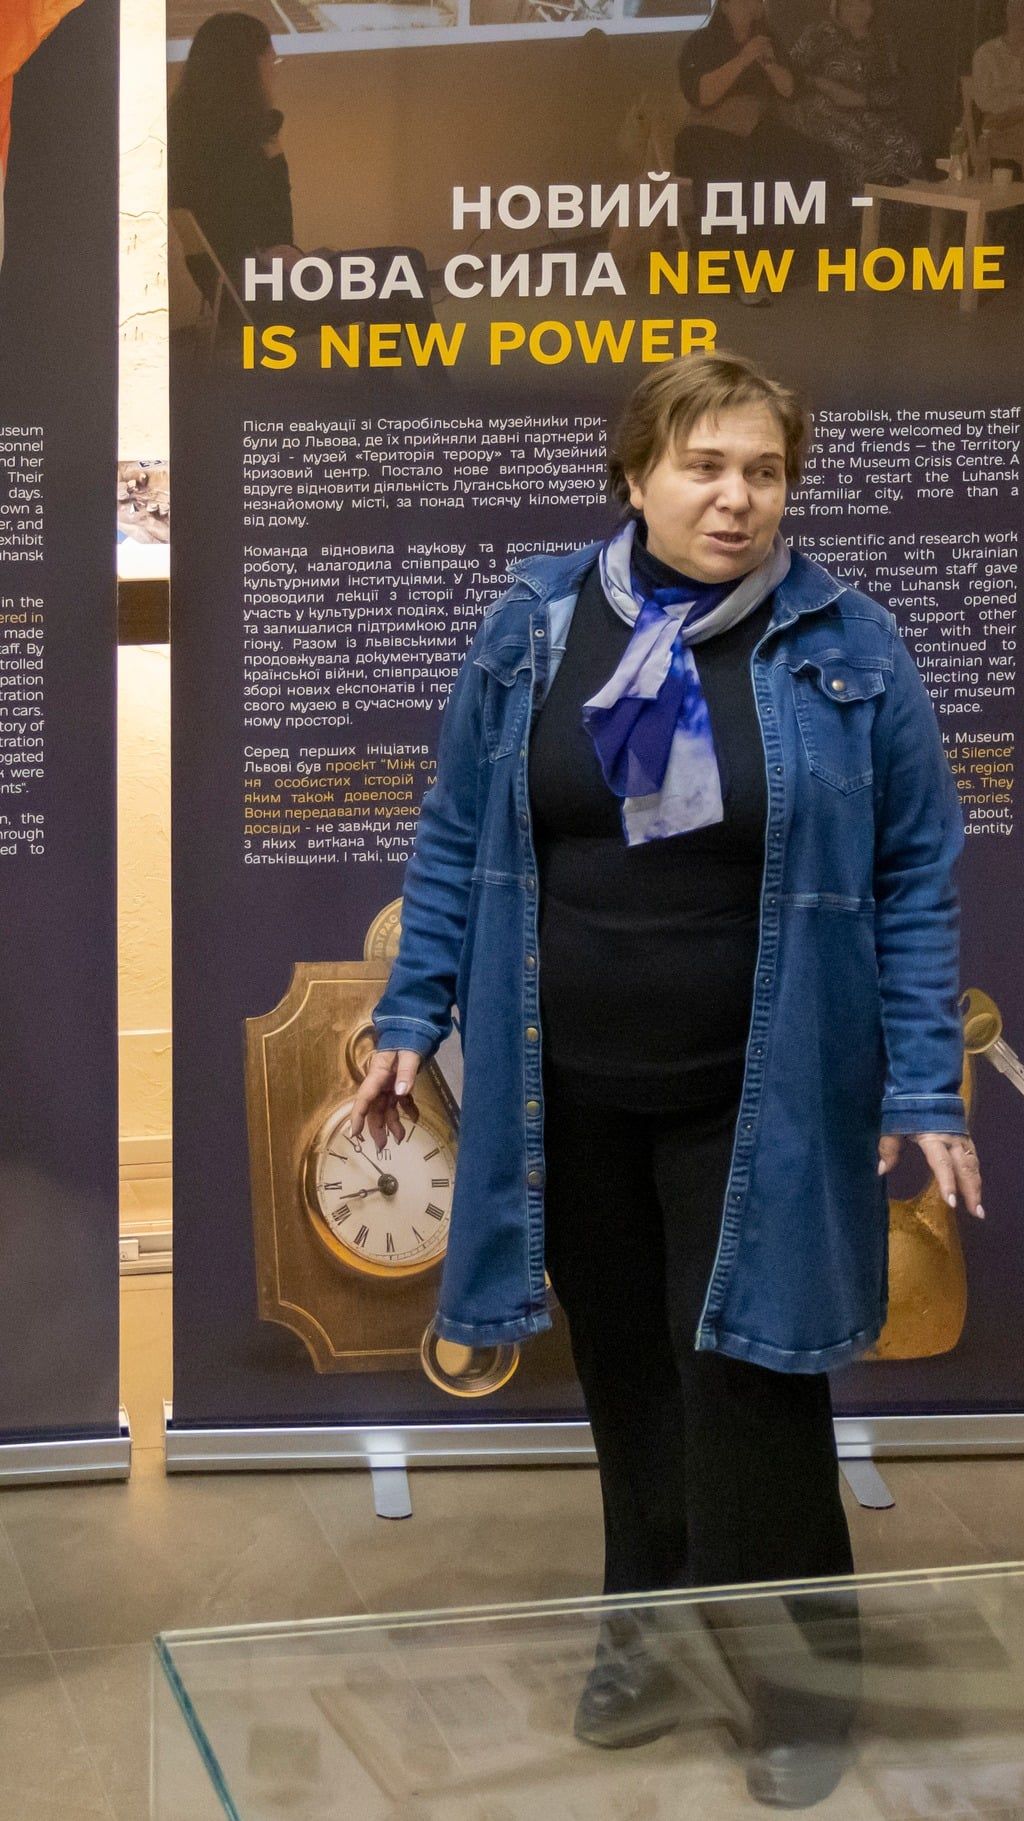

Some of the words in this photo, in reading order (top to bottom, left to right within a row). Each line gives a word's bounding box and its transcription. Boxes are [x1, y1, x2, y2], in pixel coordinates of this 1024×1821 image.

[452, 171, 678, 230] НОВИЙ
[701, 181, 826, 235] ДІМ
[244, 256, 424, 301] НОВА
[444, 252, 627, 299] СИЛА
[649, 249, 794, 295] NEW
[817, 245, 1005, 292] HOME
[243, 325, 297, 370] IS
[320, 322, 467, 369] NEW
[489, 318, 717, 366] POWER
[819, 410, 892, 422] Starobilsk,
[897, 410, 920, 421] the
[925, 410, 986, 420] museum
[990, 407, 1021, 419] staff
[244, 421, 284, 432] Після
[290, 420, 356, 433] евакуації
[361, 419, 372, 430] зі
[377, 418, 483, 431] Старобільська
[489, 416, 568, 430] музейники
[574, 417, 607, 428] при-
[814, 427, 846, 440] they
[850, 428, 885, 437] were
[889, 424, 962, 436] welcomed
[966, 424, 984, 437] by
[987, 423, 1020, 435] their
[243, 436, 278, 450] були
[282, 438, 300, 449] до
[305, 436, 360, 447] Львова,
[365, 436, 383, 447] де
[388, 436, 399, 445] їх
[404, 433, 476, 446] прийняли
[481, 432, 520, 445] давні
[524, 433, 593, 444] партнери
[599, 430, 607, 441] й
[828, 442, 855, 453] and
[861, 441, 910, 452] friends
[931, 440, 956, 451] the
[961, 439, 1020, 452] Territory
[20, 456, 44, 467] her
[243, 452, 280, 465] друзі
[303, 451, 347, 465] музей
[443, 451, 502, 462] терору»
[510, 450, 525, 459] та
[534, 446, 607, 460] Музейний
[821, 458, 846, 469] the
[850, 457, 910, 468] Museum
[914, 456, 952, 467] Crisis
[956, 455, 1006, 466] Centre.
[1010, 454, 1020, 465] A
[8, 472, 44, 483] Their
[838, 473, 853, 484] to
[866, 472, 912, 483] restart
[925, 472, 949, 482] the
[962, 470, 1019, 482] Luhansk
[8, 488, 44, 501] days.
[244, 485, 293, 497] вдруге
[297, 484, 370, 495] відновити
[374, 481, 449, 493] діяльність
[453, 479, 544, 493] Луганського
[548, 480, 596, 491] музею
[599, 480, 608, 491] у
[791, 488, 862, 500] unfamiliar
[874, 488, 904, 501] city,
[917, 488, 954, 498] more
[967, 486, 998, 497] than
[1011, 487, 1019, 496] a
[17, 519, 43, 530] and
[244, 515, 265, 527] від
[268, 516, 309, 528] дому.
[819, 534, 885, 546] scientific
[888, 534, 915, 545] and
[920, 533, 980, 544] research
[984, 531, 1018, 543] work
[244, 546, 308, 558] Команда
[322, 545, 395, 556] відновила
[408, 543, 466, 556] наукову
[479, 544, 494, 553] та
[904, 549, 935, 560] with
[952, 547, 1018, 559] Ukrainian
[244, 561, 297, 574] роботу,
[308, 561, 392, 572] налагодила
[402, 559, 480, 570] співпрацю
[837, 566, 867, 577] Lviv,
[876, 566, 938, 576] museum
[946, 563, 977, 575] staff
[985, 564, 1018, 576] gave
[244, 577, 340, 590] культурними
[348, 574, 446, 587] інституціями.
[868, 581, 892, 592] the
[901, 579, 960, 591] Luhansk
[969, 578, 1017, 592] region,
[2, 597, 14, 607] in
[20, 597, 44, 608] the
[244, 594, 324, 605] проводили
[336, 590, 378, 602] лекції
[408, 589, 453, 602] історії
[888, 596, 939, 607] events,
[964, 593, 1017, 607] opened
[4, 628, 44, 639] made
[243, 625, 259, 634] та
[263, 624, 352, 634] залишалися
[358, 621, 446, 633] підтримкою
[940, 625, 971, 636] with
[984, 624, 1017, 635] their
[27, 643, 44, 657] By
[12, 707, 44, 716] cars.
[956, 733, 1014, 743] Museum
[244, 746, 290, 759] Серед
[300, 747, 356, 758] перших
[367, 744, 429, 755] ініціатив
[10, 769, 44, 778] were
[970, 762, 1014, 775] region
[274, 777, 351, 788] особистих
[364, 774, 414, 787] історій
[979, 777, 1014, 790] They
[244, 792, 281, 803] яким
[291, 792, 334, 803] також
[344, 791, 413, 802] довелося
[21, 813, 44, 824] the
[969, 808, 1013, 819] about,
[352, 851, 382, 862] такі,
